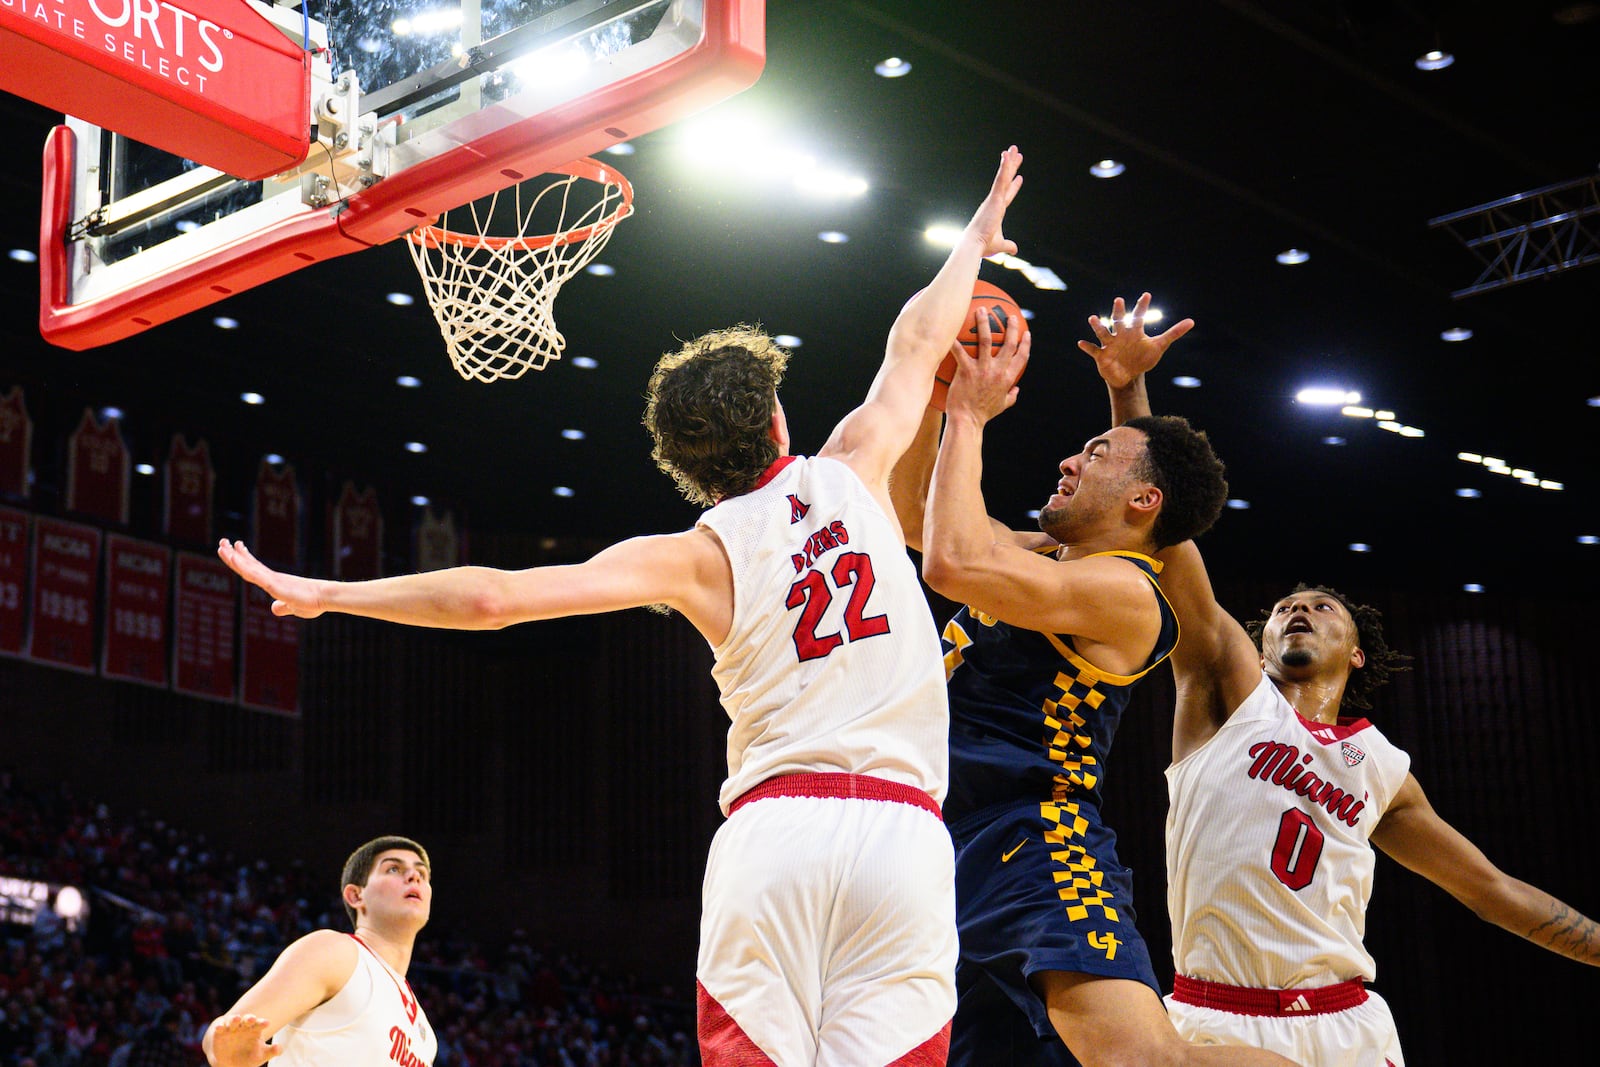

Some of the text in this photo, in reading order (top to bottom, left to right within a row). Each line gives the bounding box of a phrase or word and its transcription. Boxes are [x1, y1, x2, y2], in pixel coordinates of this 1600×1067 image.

[56, 0, 224, 73] ORTS
[104, 33, 208, 93] SELECT
[785, 551, 891, 662] 22
[1248, 740, 1369, 828] Miami
[1270, 806, 1324, 891] 0
